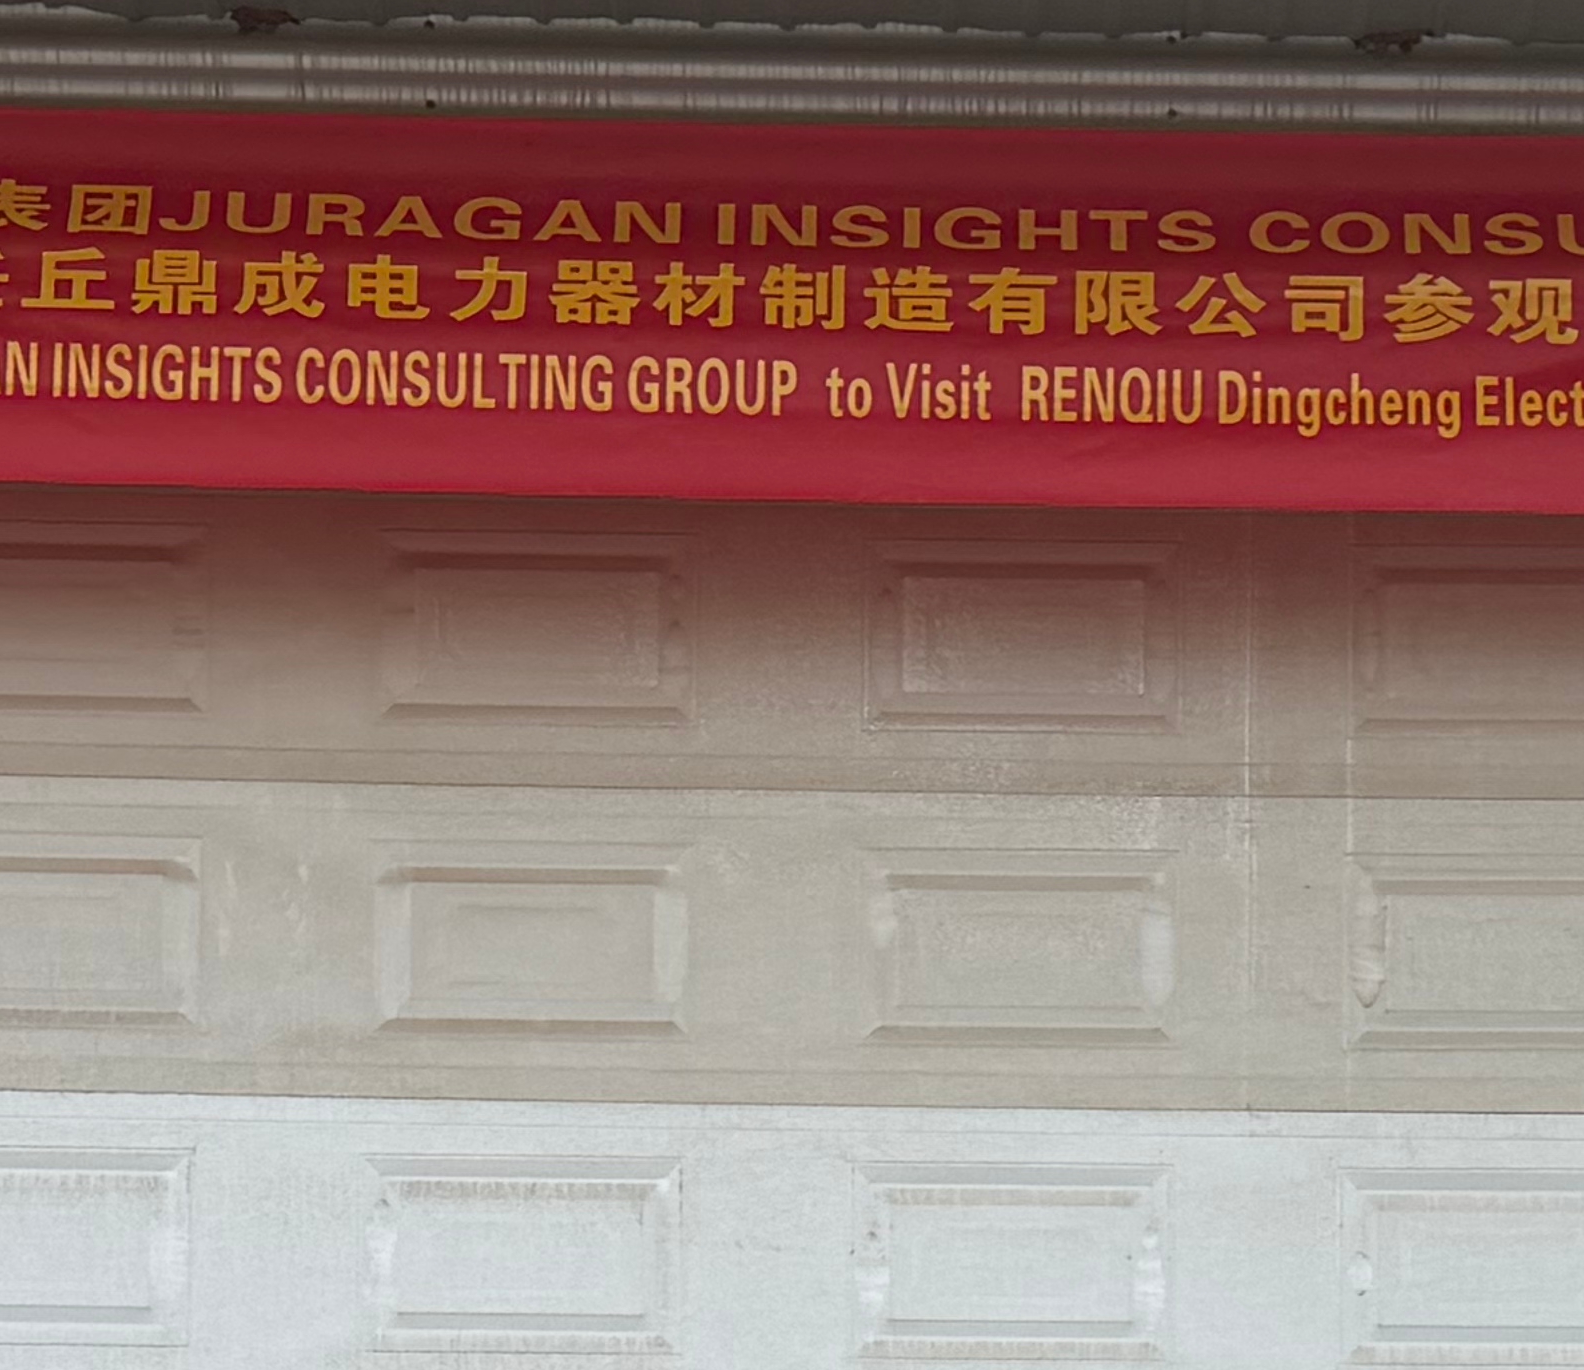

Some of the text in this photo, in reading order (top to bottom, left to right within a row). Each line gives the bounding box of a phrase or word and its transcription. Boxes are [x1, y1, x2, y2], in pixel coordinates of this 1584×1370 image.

[717, 203, 1216, 253] INSIGHTS
[52, 343, 284, 404] INSIGHTS
[296, 348, 614, 413] CONSULTING
[628, 356, 799, 417] GROUP
[826, 370, 874, 419] to
[887, 363, 992, 422] Visit
[1021, 366, 1204, 426] RENQIU
[1218, 370, 1462, 441] Dingcheng
